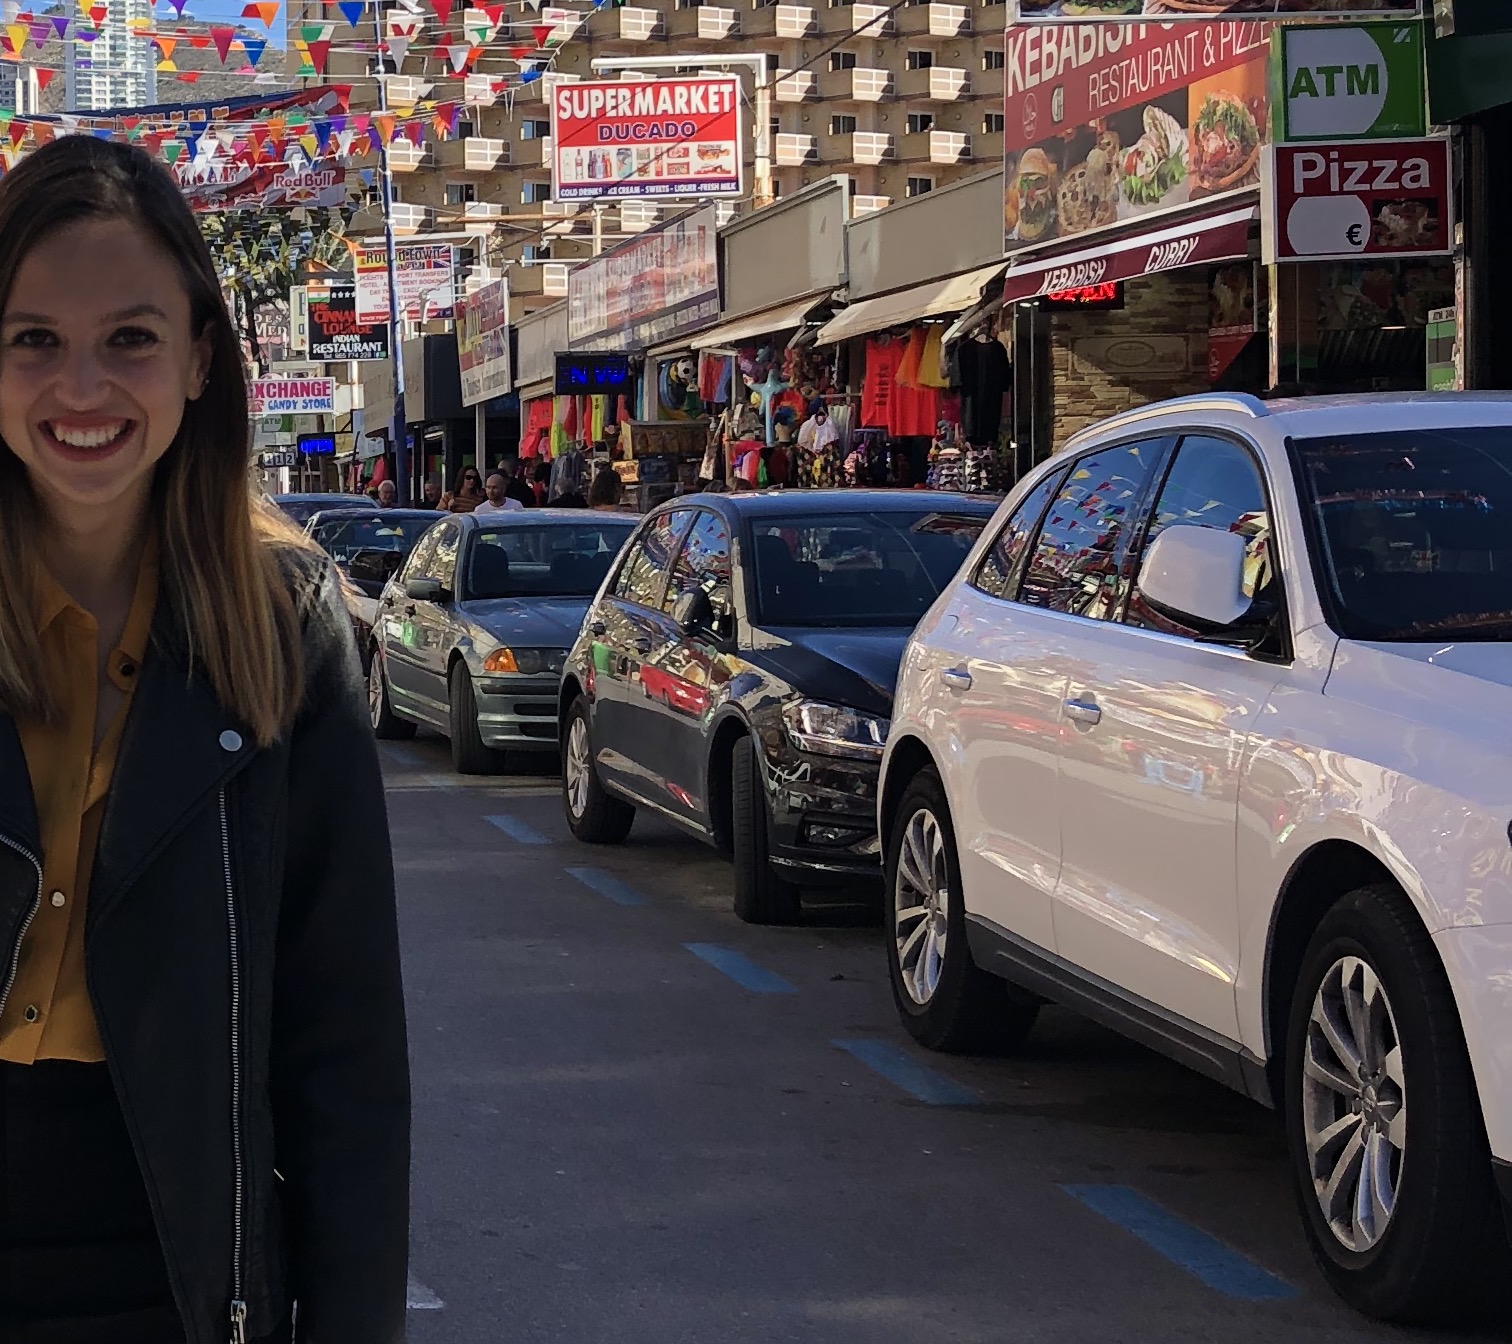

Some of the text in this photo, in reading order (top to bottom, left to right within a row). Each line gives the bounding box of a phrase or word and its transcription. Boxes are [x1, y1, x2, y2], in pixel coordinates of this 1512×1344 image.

[1006, 22, 1148, 97] KEBABIS
[1089, 30, 1199, 111] RESTAURANT
[1203, 25, 1215, 66] &
[1290, 64, 1379, 98] ATM
[559, 84, 734, 120] SUPERMARKET
[598, 121, 696, 141] DUCADO
[275, 172, 333, 187] Red Bull
[1293, 152, 1430, 194] Pizza
[1036, 236, 1199, 294] KEBABISH CURRY
[312, 342, 382, 354] RESTAURANT
[333, 335, 360, 343] INDIAN
[268, 398, 332, 410] CANDY STORE
